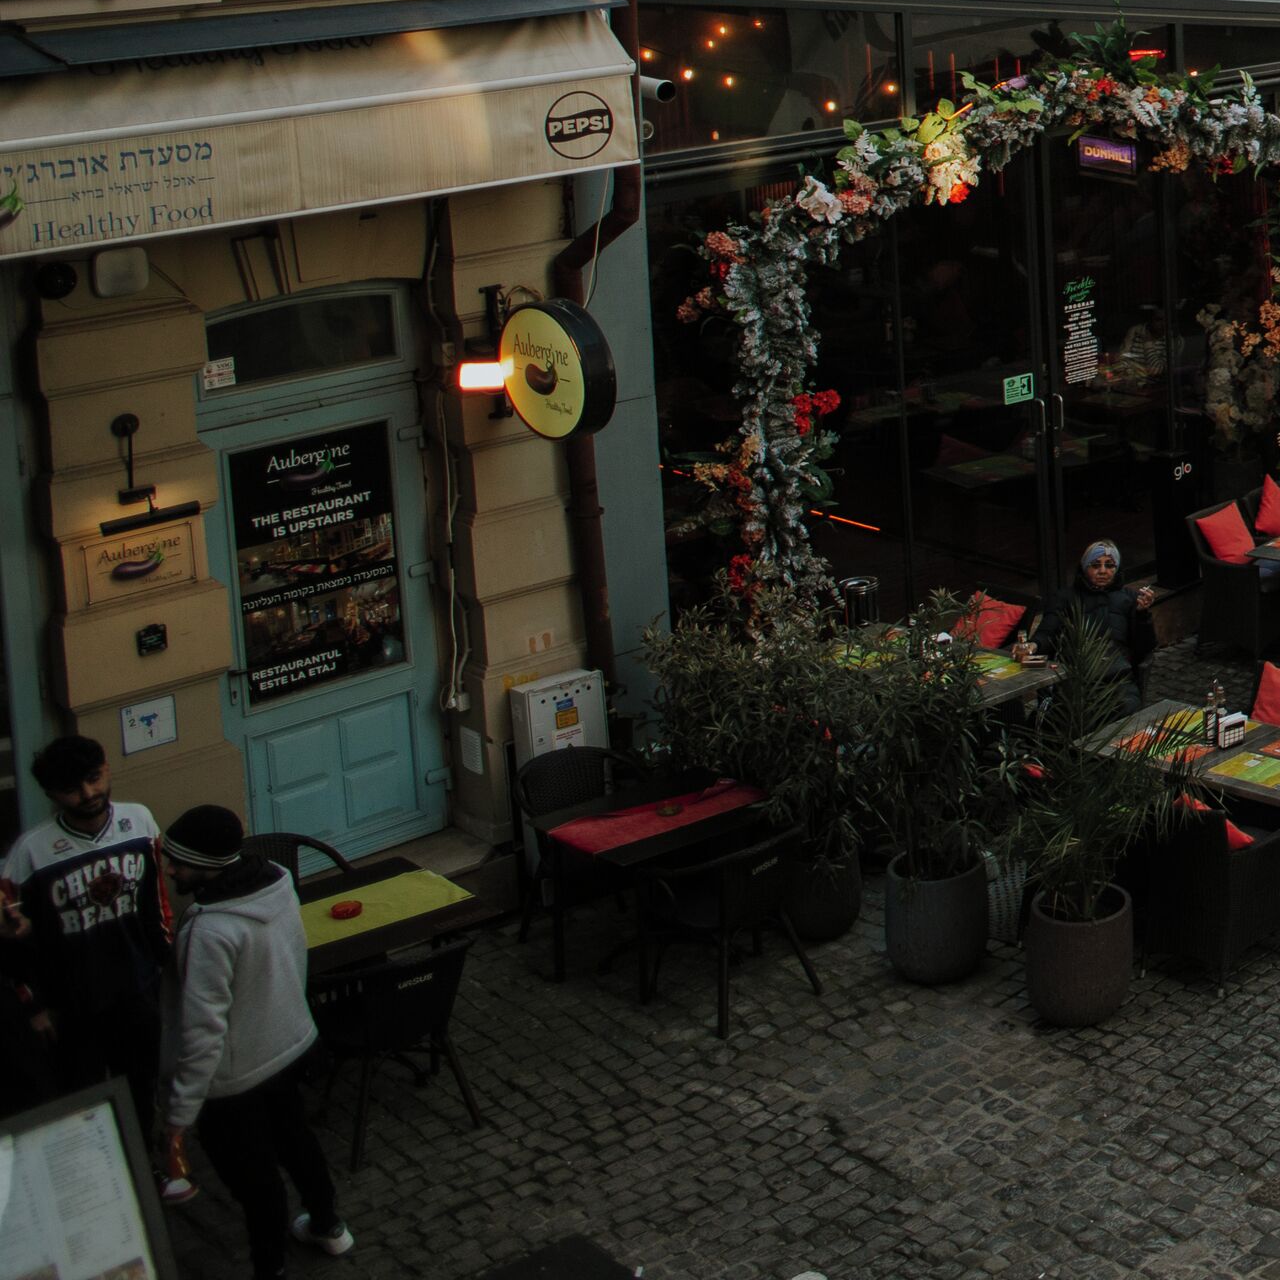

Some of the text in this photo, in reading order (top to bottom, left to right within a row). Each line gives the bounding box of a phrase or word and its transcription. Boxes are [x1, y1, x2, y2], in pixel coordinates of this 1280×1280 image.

[548, 113, 610, 138] PEPSI
[119, 142, 213, 171] מסעדת
[1083, 145, 1132, 164] DUNHILL
[33, 197, 214, 244] Healthy Food
[1064, 300, 1095, 311] PROGRAM
[513, 333, 569, 368] Aubergine
[266, 442, 351, 473] Aubergine
[1173, 461, 1193, 481] glo
[251, 491, 372, 529] THE RESTAURANT
[273, 509, 355, 538] IS UPSTAIRS
[96, 535, 181, 566] Aubergine
[251, 649, 342, 681] RESTAURANTUL
[259, 661, 337, 691] ESTE LA ETAJ
[129, 718, 137, 728] 2
[51, 853, 146, 908] CHICAGO
[60, 887, 139, 935] BEAR
